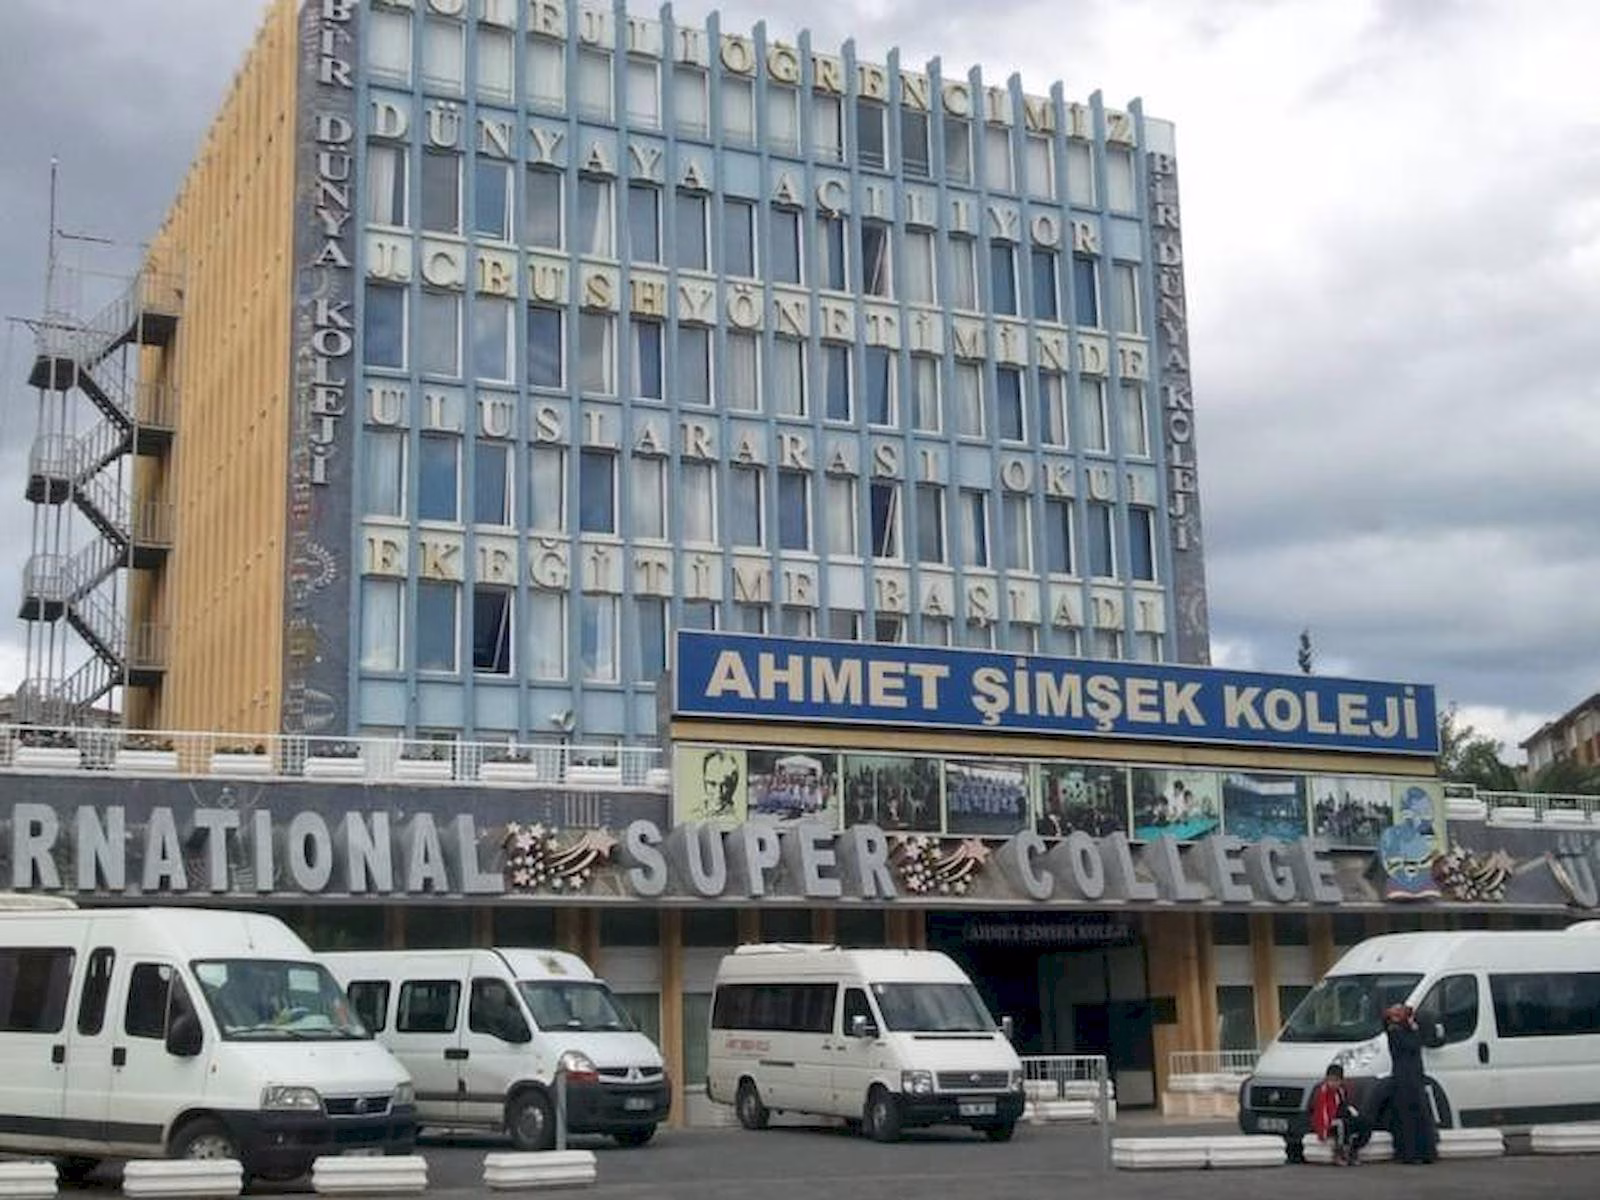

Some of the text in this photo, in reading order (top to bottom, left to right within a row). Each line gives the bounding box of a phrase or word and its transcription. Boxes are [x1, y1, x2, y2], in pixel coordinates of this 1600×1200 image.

[313, 114, 353, 269] DÜNYA
[371, 101, 1102, 256] DÜNYAYA AÇILIYOR
[309, 299, 353, 487] KOLEJİ
[366, 387, 1156, 506] ULUSLARARASI OKUL
[873, 577, 1163, 635] BAŞLADI
[705, 649, 1419, 740] AHMET ŞİMŞEK KOLEJİ
[12, 802, 506, 894] RNATIONAL
[625, 819, 898, 899] SUPER
[1004, 829, 1343, 904] COLLEGE
